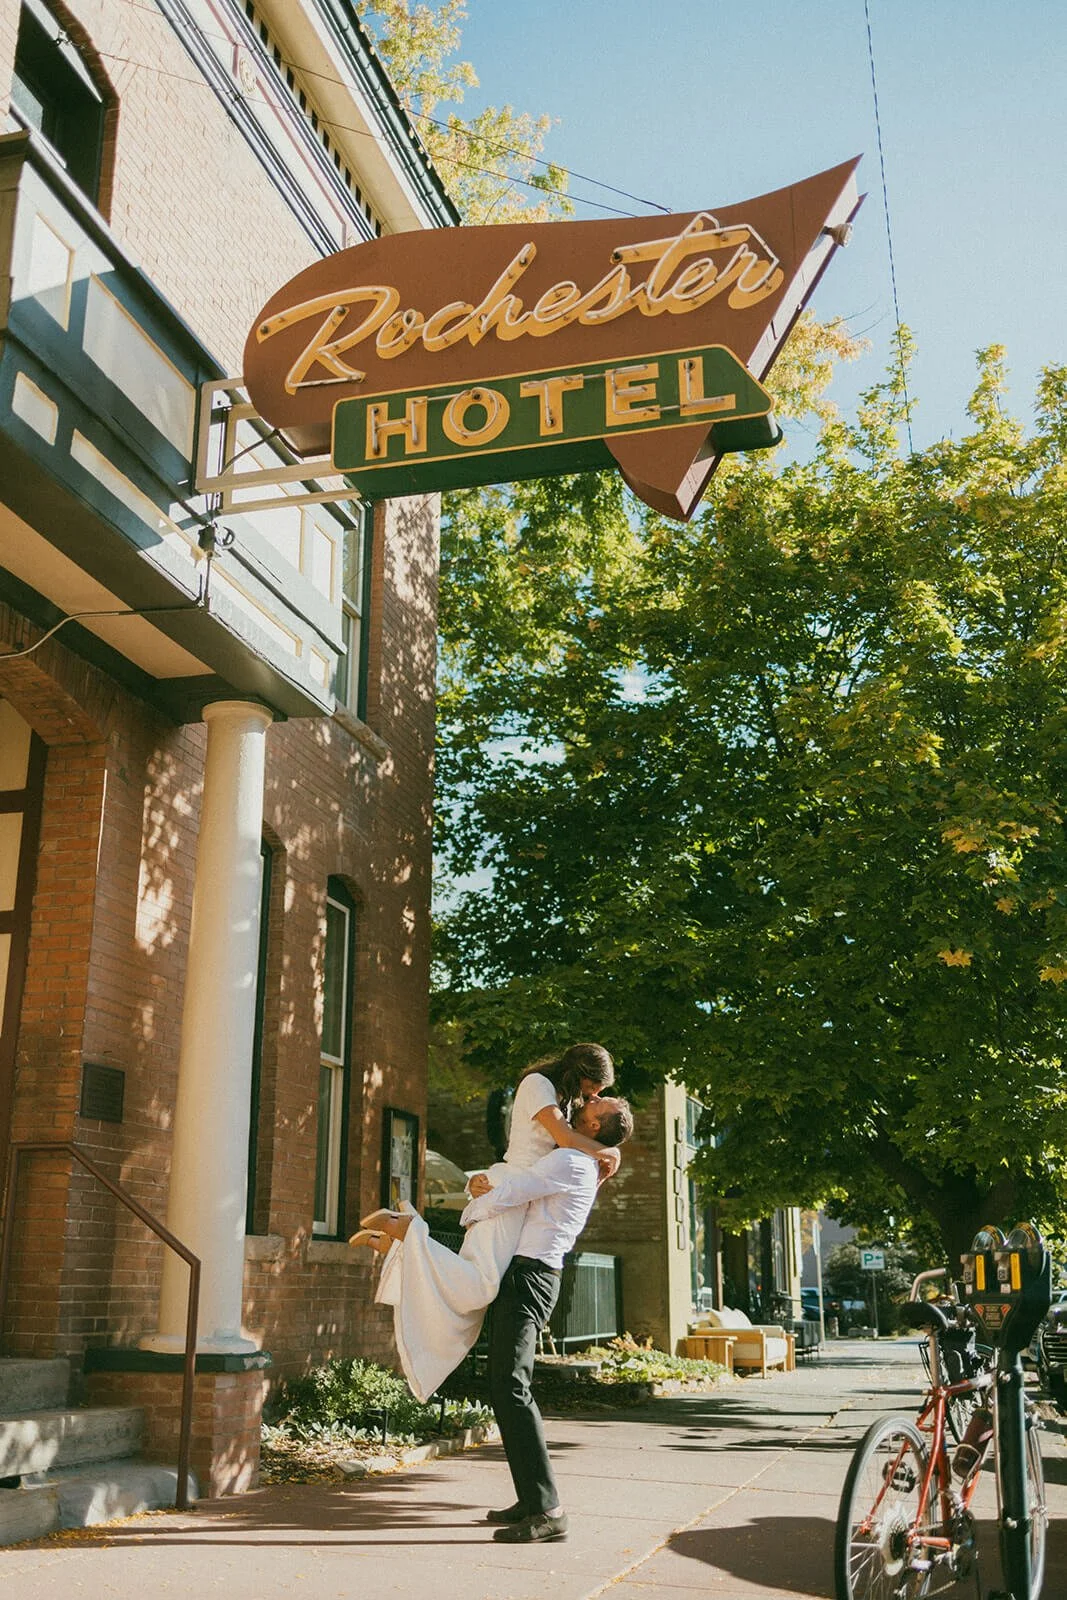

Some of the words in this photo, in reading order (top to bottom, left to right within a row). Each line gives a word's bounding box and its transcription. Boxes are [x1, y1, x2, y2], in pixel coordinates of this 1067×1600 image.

[256, 212, 784, 395] Rochester
[365, 356, 737, 461] HOTEL
[863, 1253, 874, 1266] P
